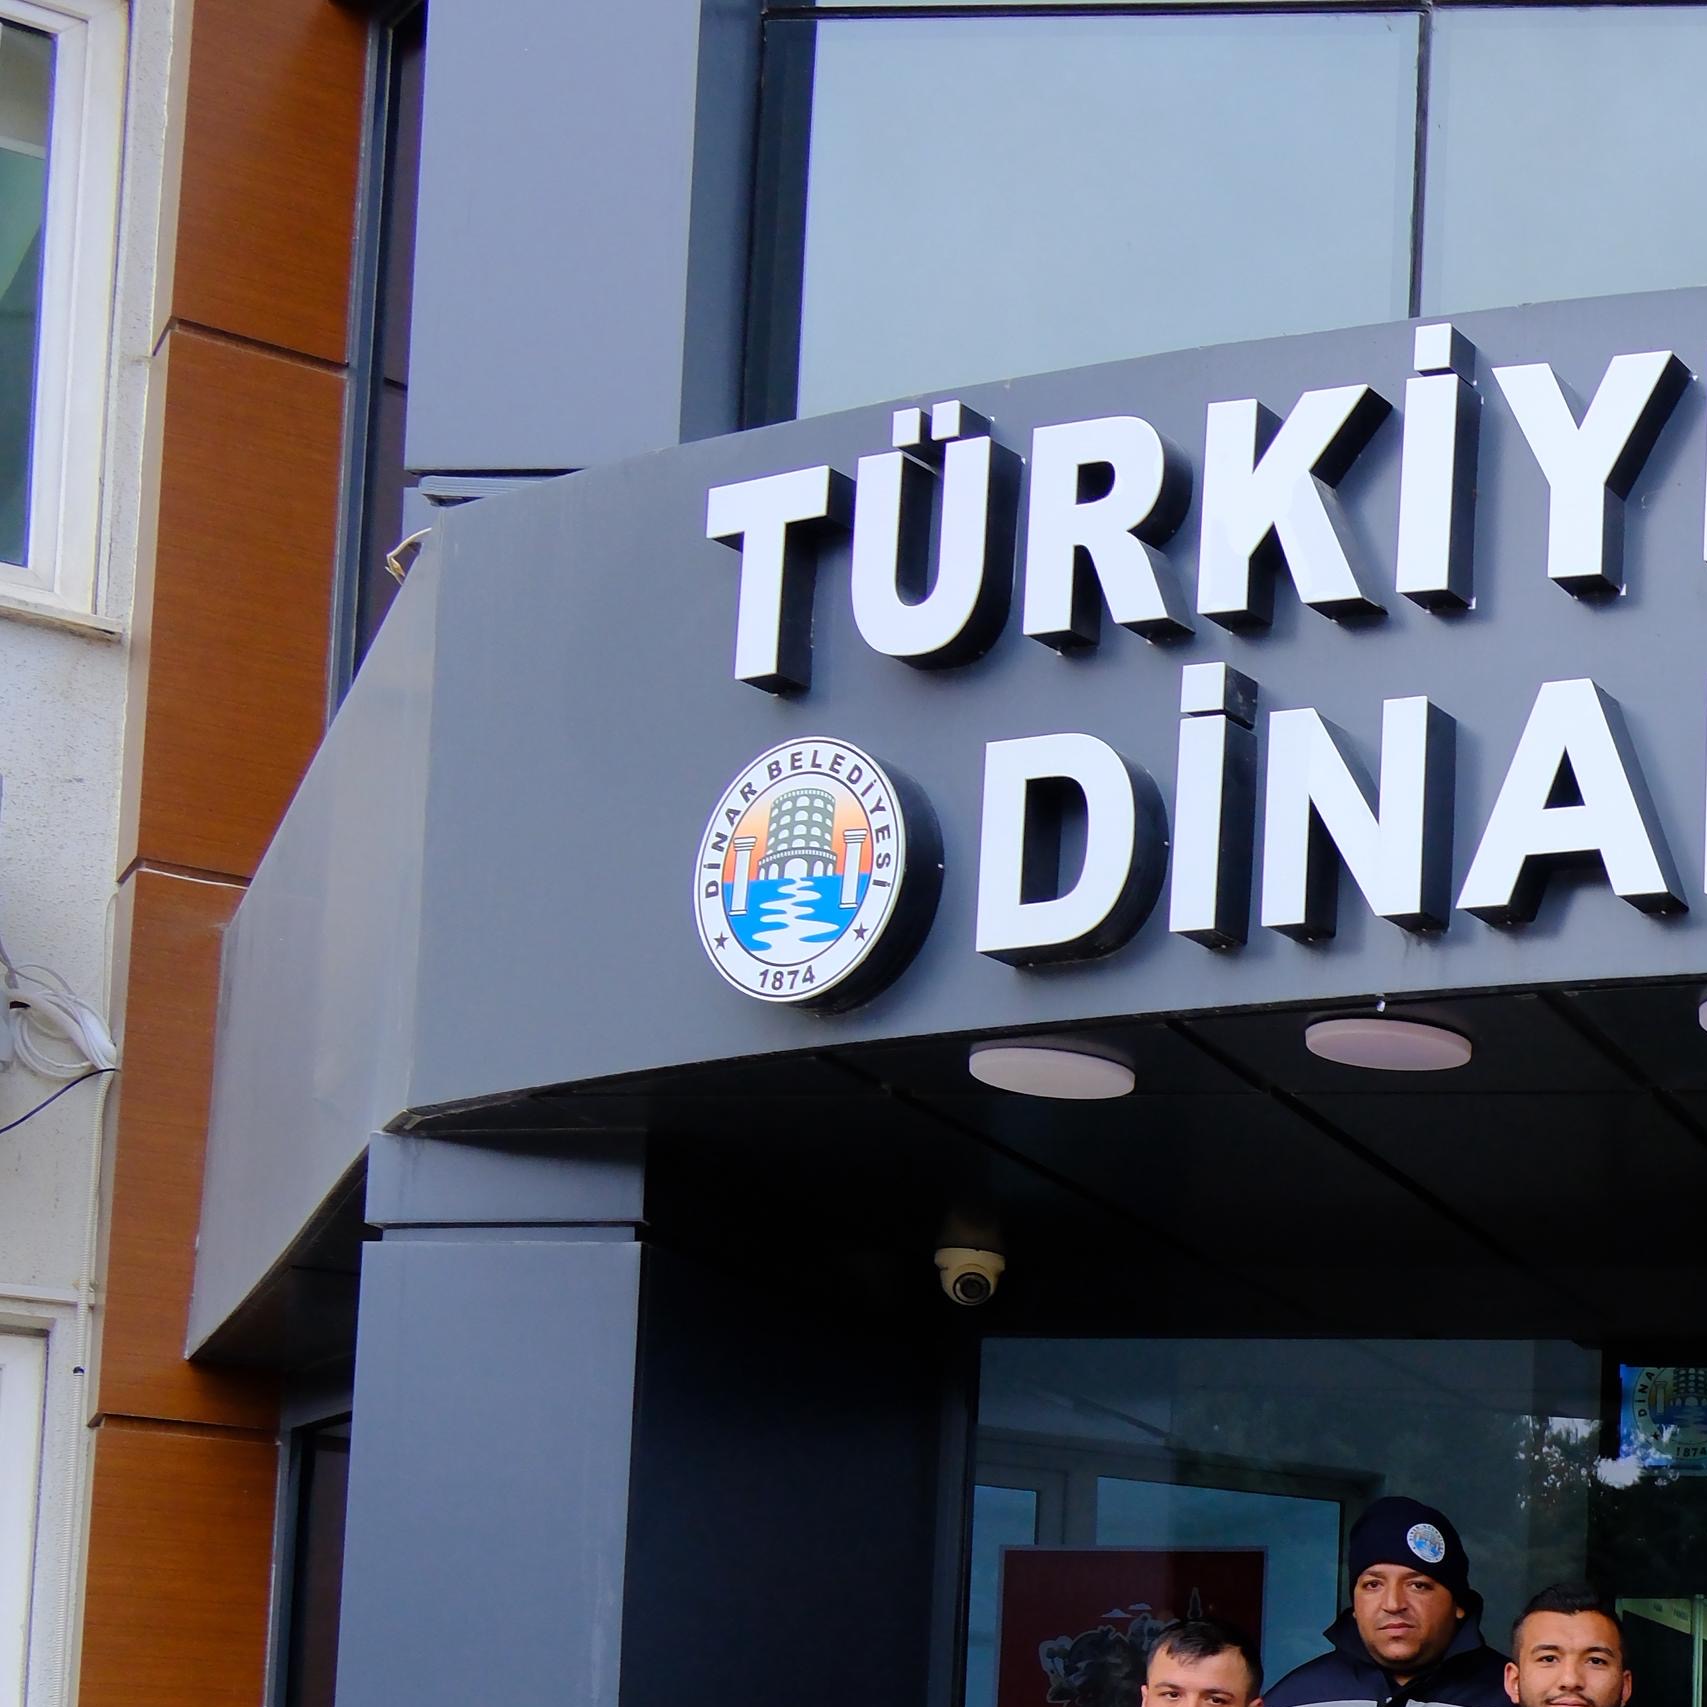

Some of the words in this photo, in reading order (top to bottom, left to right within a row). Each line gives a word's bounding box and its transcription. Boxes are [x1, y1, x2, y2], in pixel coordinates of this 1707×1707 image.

[704, 781, 757, 898] DİNAR
[767, 749, 891, 888] BELEDİYESİ
[759, 965, 815, 990] 1874
